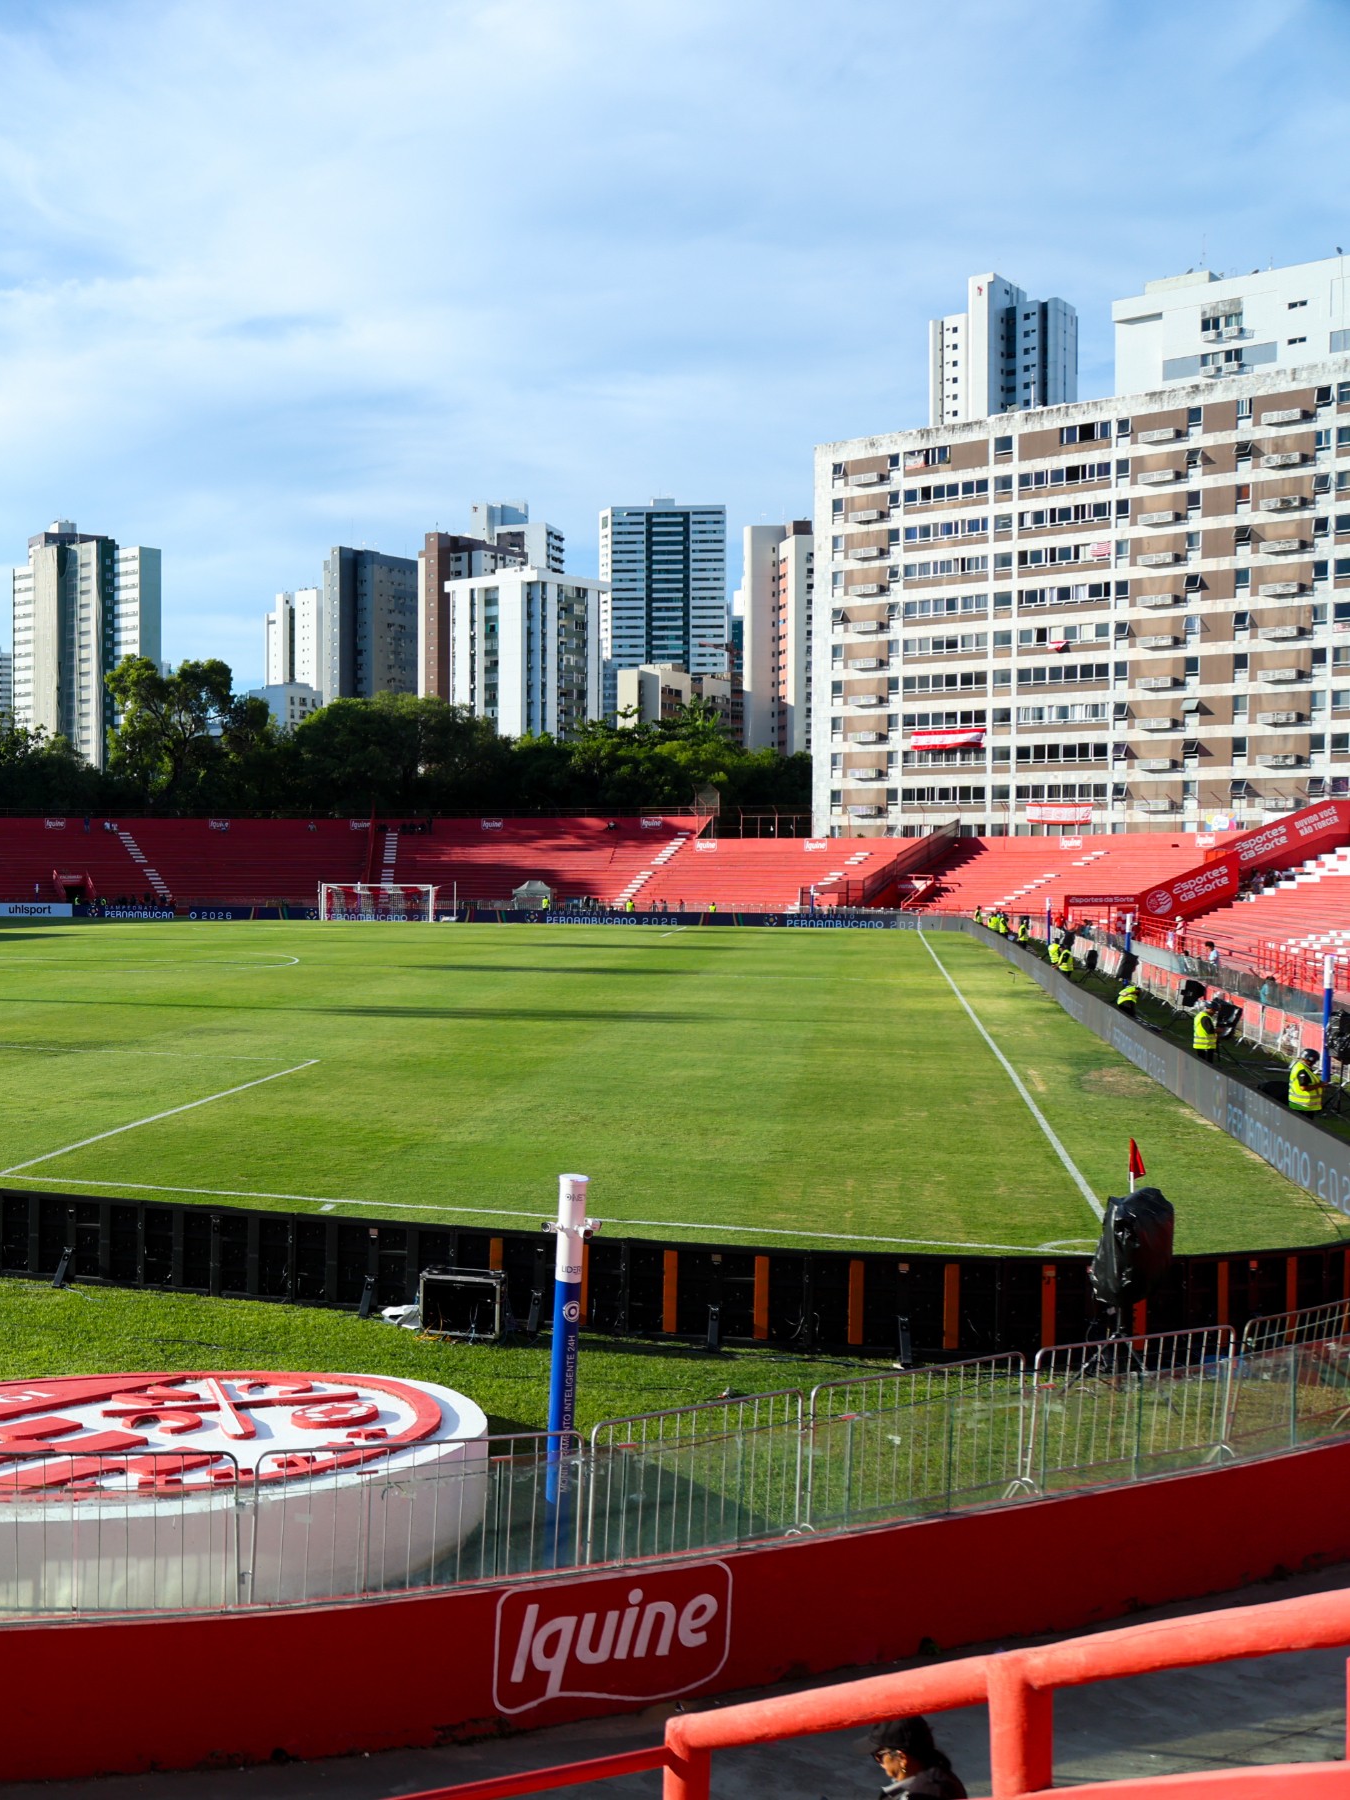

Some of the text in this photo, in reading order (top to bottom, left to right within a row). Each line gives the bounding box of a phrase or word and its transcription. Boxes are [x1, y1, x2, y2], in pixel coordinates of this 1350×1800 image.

[1294, 806, 1337, 829] DUVIDO VOCÊ
[47, 820, 64, 828] Iquine
[352, 820, 370, 829] Iquine
[483, 820, 501, 829] Iquine
[642, 819, 661, 828] Iquine
[1299, 816, 1339, 836] NÃO TORCER
[1235, 825, 1287, 850] Esportes
[696, 841, 715, 850] Iquine
[806, 840, 826, 850] Iquine
[1061, 838, 1081, 848] Iquine
[1240, 836, 1288, 861] da Sorte
[1173, 865, 1228, 895] Esportes
[1179, 876, 1230, 902] da Sorte
[8, 905, 52, 915] uhlsport
[202, 912, 232, 920] 2026
[787, 920, 922, 930] PERNAMBUCANO 2026
[564, 1354, 575, 1412] INTELIGENTE
[510, 1587, 719, 1695] Iquine
